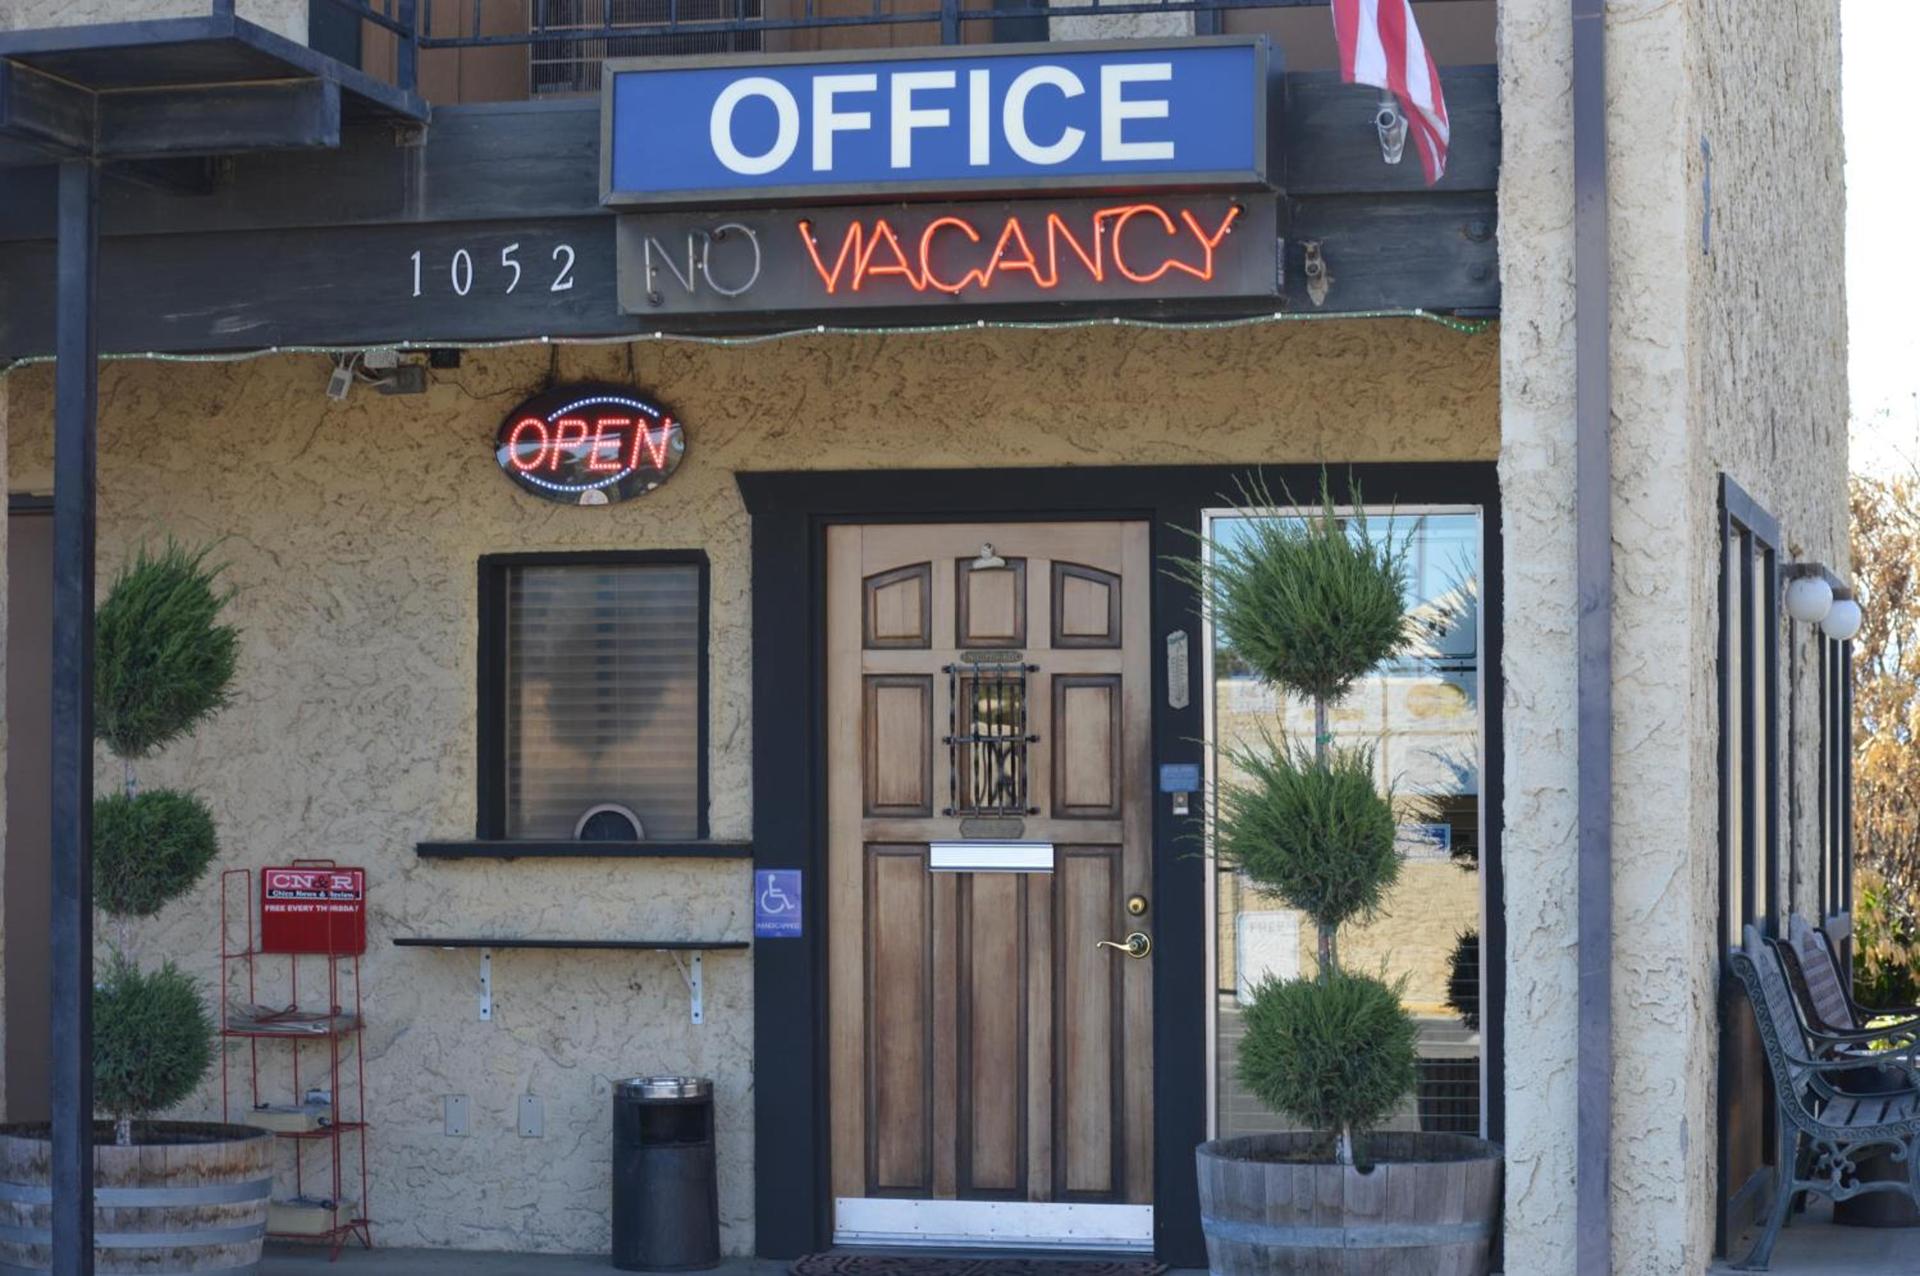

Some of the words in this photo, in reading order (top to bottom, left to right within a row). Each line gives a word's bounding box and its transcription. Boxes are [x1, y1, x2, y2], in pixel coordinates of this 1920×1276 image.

[709, 62, 1175, 176] OFFICE
[410, 243, 576, 297] 1052
[644, 223, 761, 296] NO
[798, 204, 1243, 293] VACANCY
[509, 417, 672, 471] OPEN
[264, 904, 286, 912] FREE
[287, 904, 314, 912] EVERY
